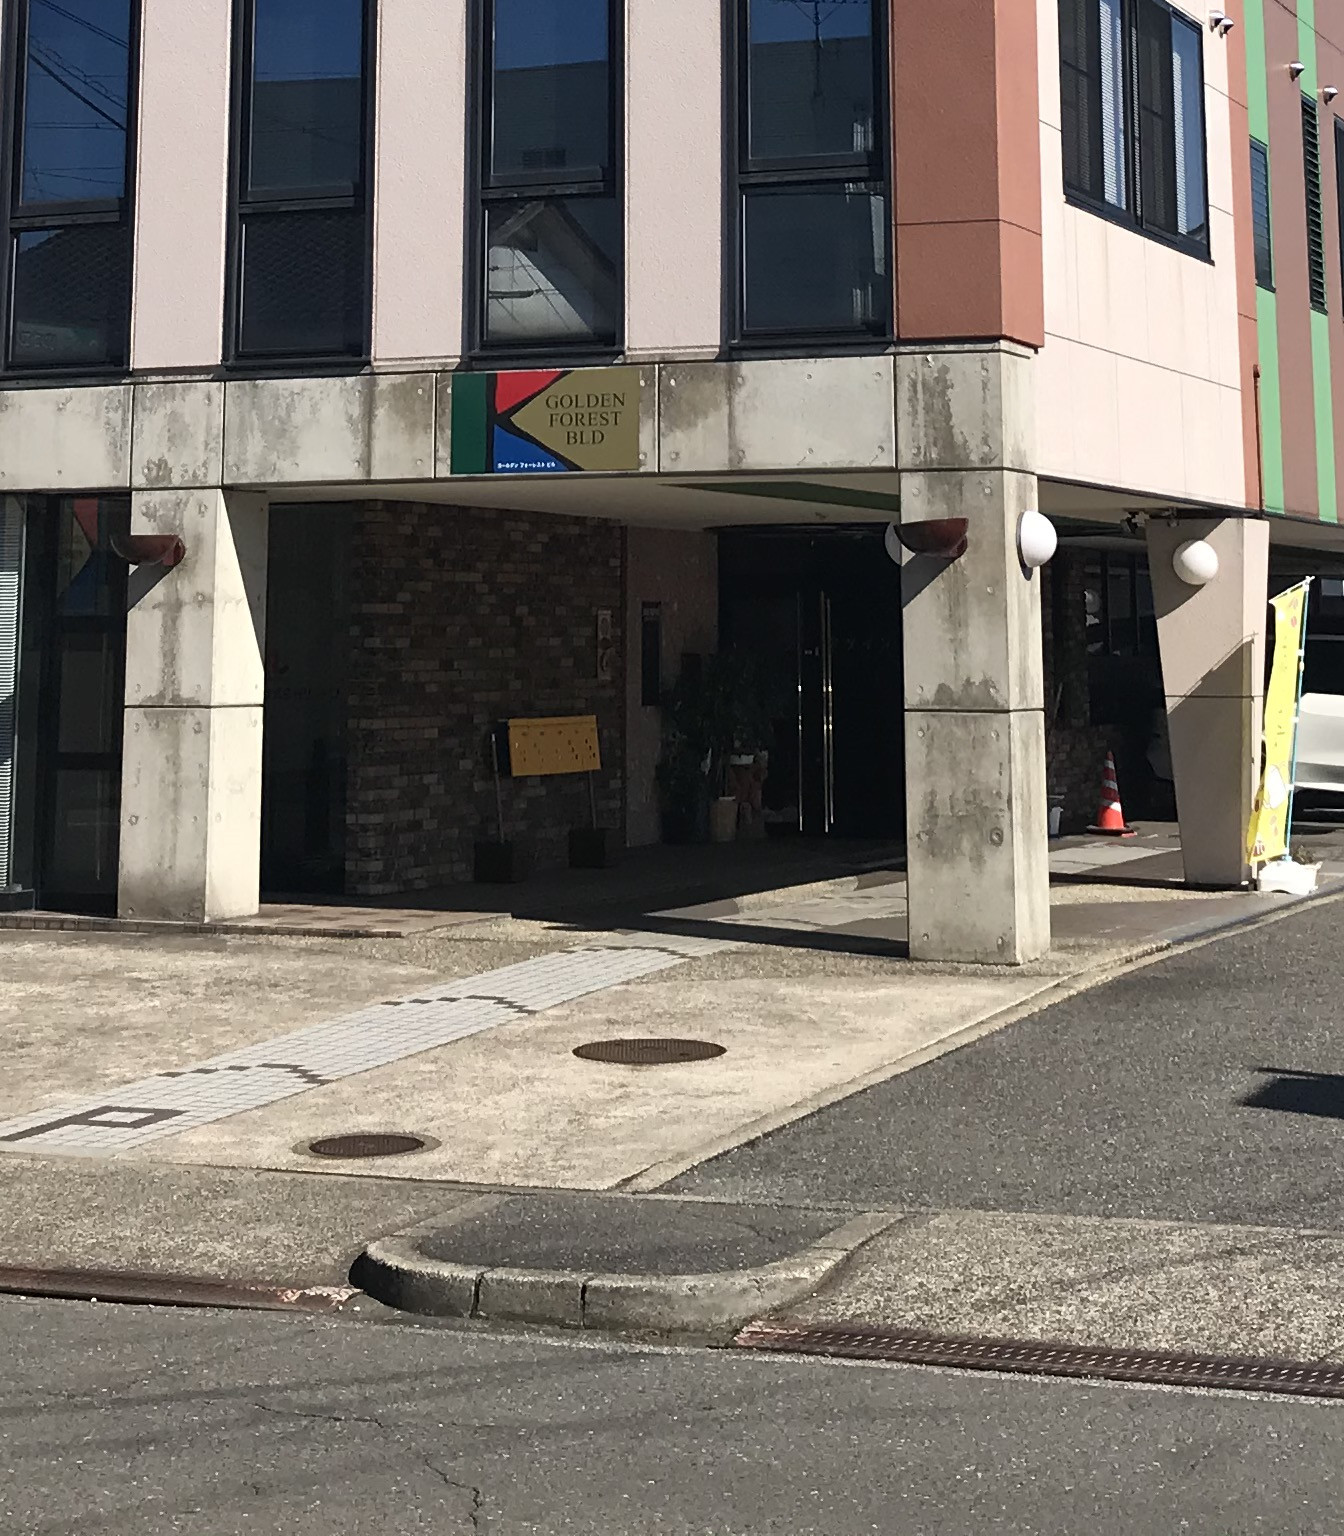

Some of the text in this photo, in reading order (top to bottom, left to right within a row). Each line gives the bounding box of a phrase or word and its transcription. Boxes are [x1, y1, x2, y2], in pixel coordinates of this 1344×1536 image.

[546, 393, 626, 410] GOLDEN
[549, 411, 622, 427] FOREST
[566, 430, 605, 445] BLD
